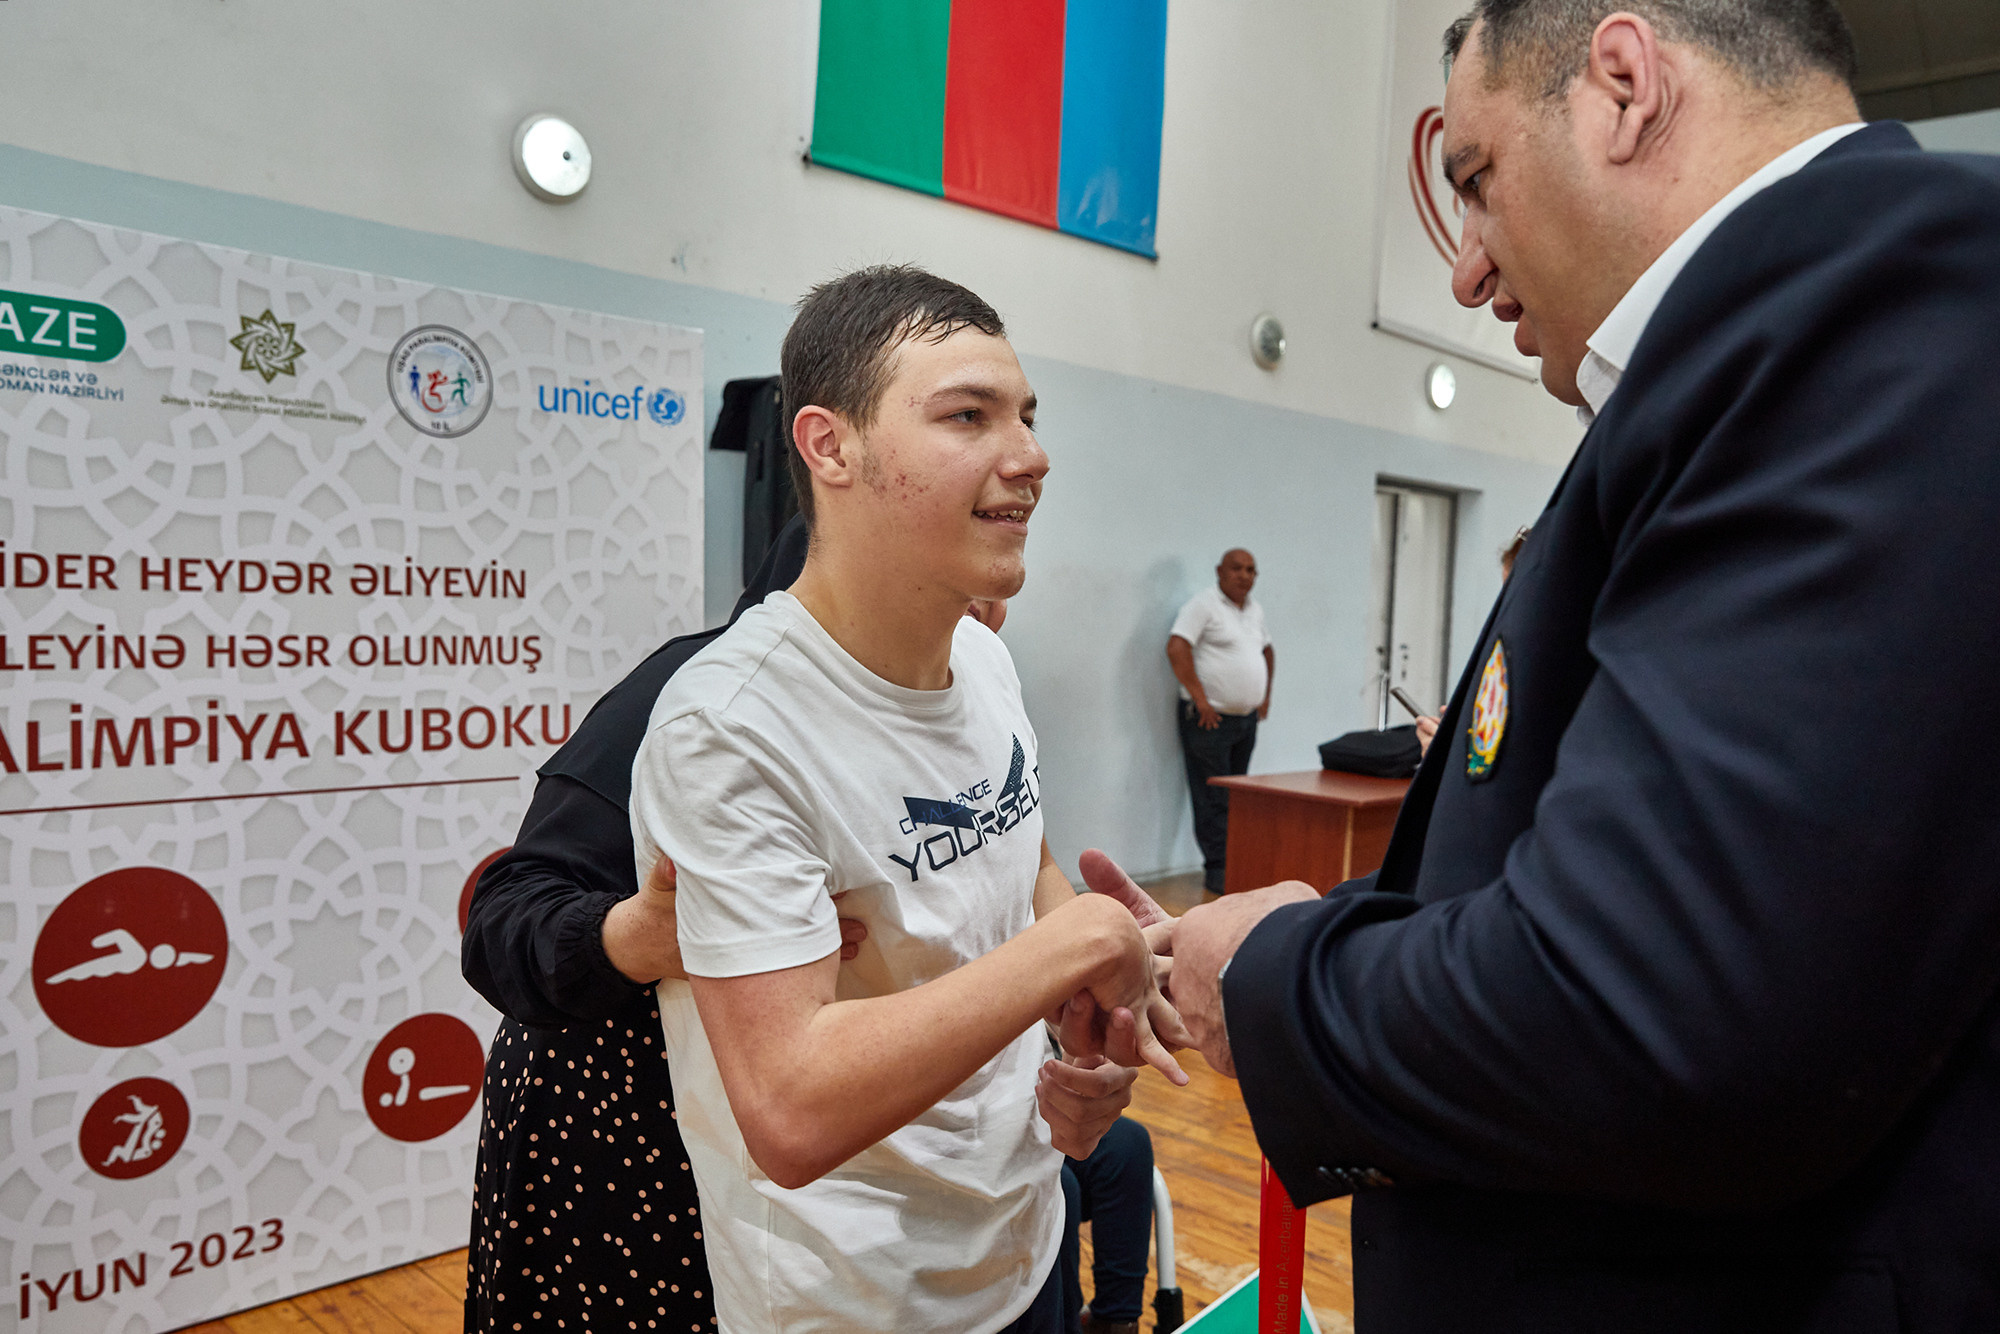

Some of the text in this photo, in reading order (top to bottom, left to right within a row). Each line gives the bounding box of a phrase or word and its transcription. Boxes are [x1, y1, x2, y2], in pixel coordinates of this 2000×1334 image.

[0, 301, 97, 352] AZE
[0, 364, 98, 386] ƏNCLƏR VƏ
[49, 383, 124, 401] NAZİRLİYİ
[538, 379, 644, 421] unicef
[140, 557, 333, 595] HEYDƏR
[350, 556, 526, 599] ƏLİYEVİN
[0, 624, 542, 673] LEYİNƏ HƏSR OLUNMUŞ
[335, 704, 571, 756] KUBOKU
[899, 779, 992, 835] CHALLENGE
[20, 1218, 284, 1320] İYUN 2023
[1276, 1277, 1289, 1289] in
